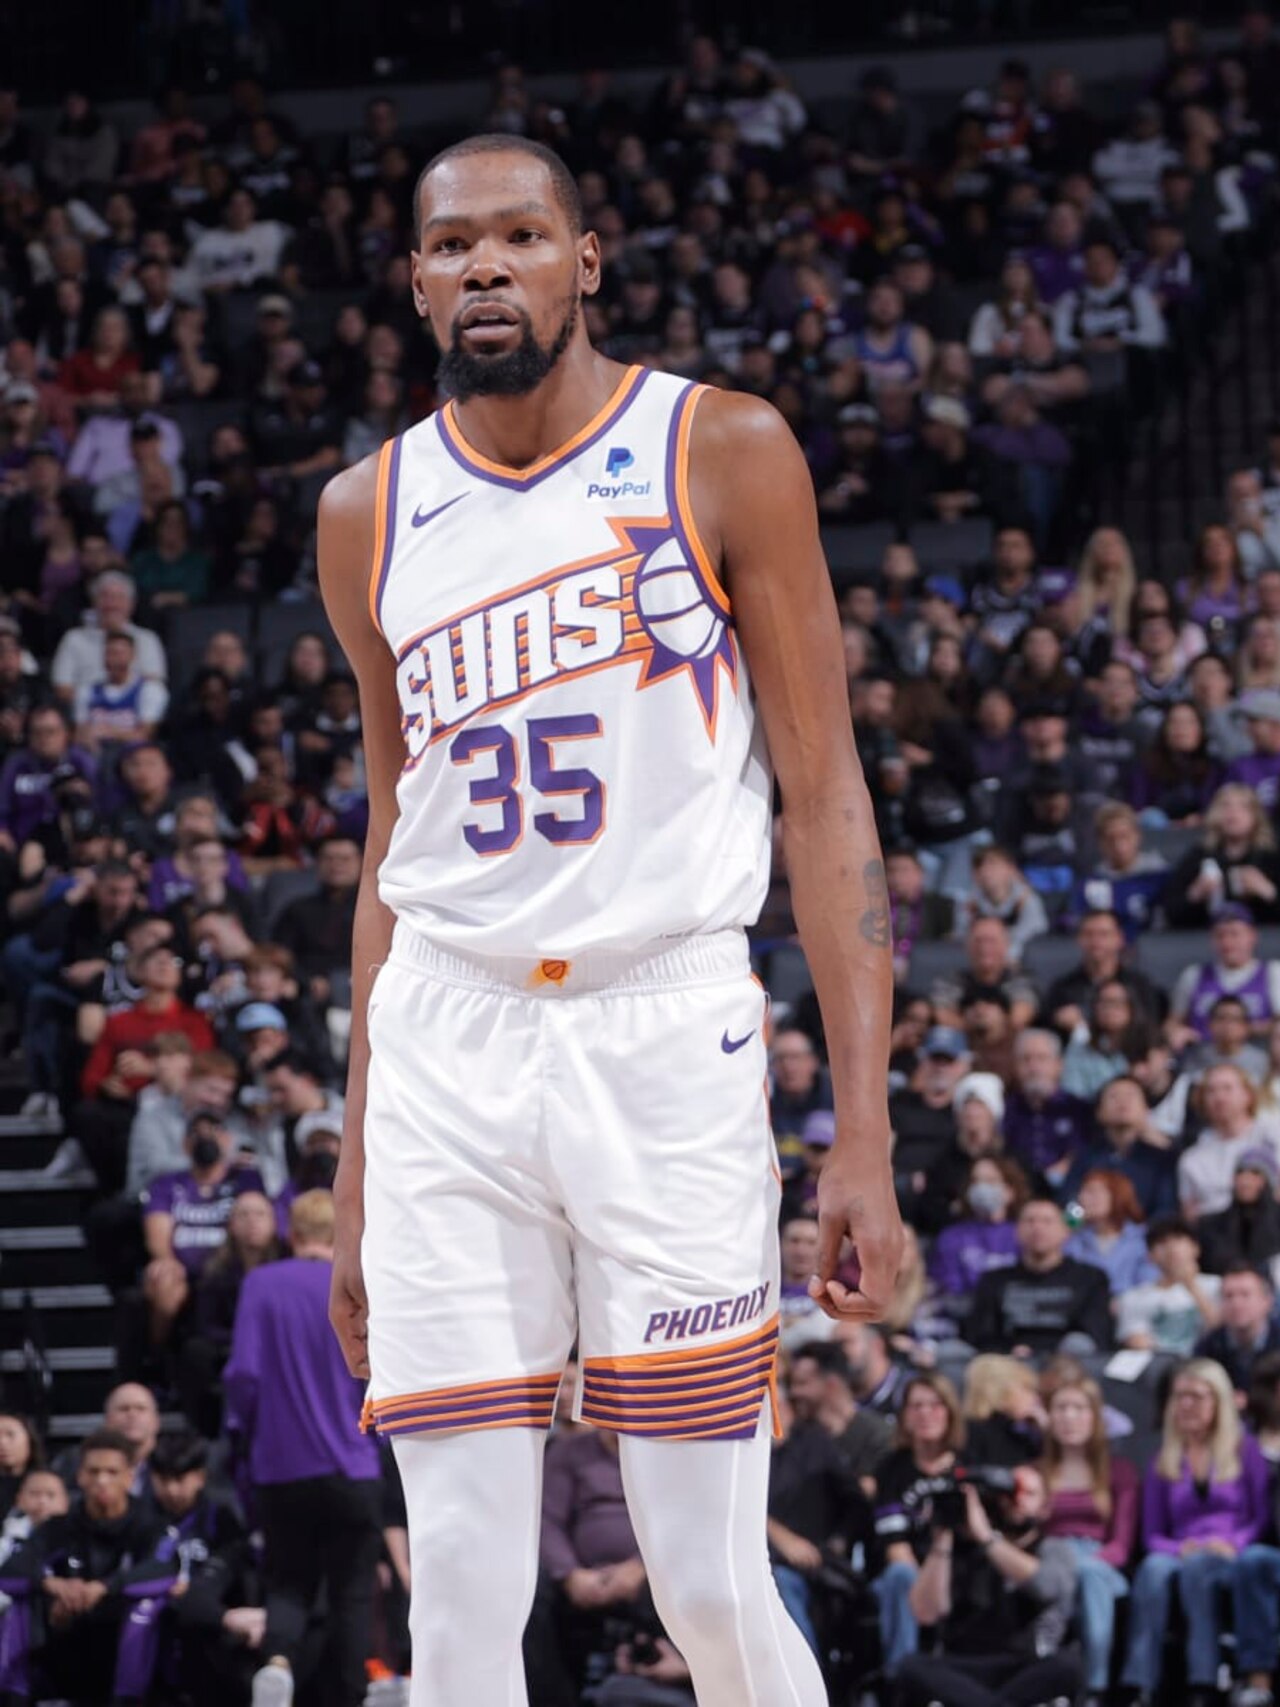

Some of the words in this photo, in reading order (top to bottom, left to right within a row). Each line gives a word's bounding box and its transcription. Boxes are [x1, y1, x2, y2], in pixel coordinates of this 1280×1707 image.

[587, 481, 650, 498] PayPal
[397, 565, 624, 758] SUNS
[449, 713, 607, 858] 35
[643, 1281, 770, 1343] PHOENIX
